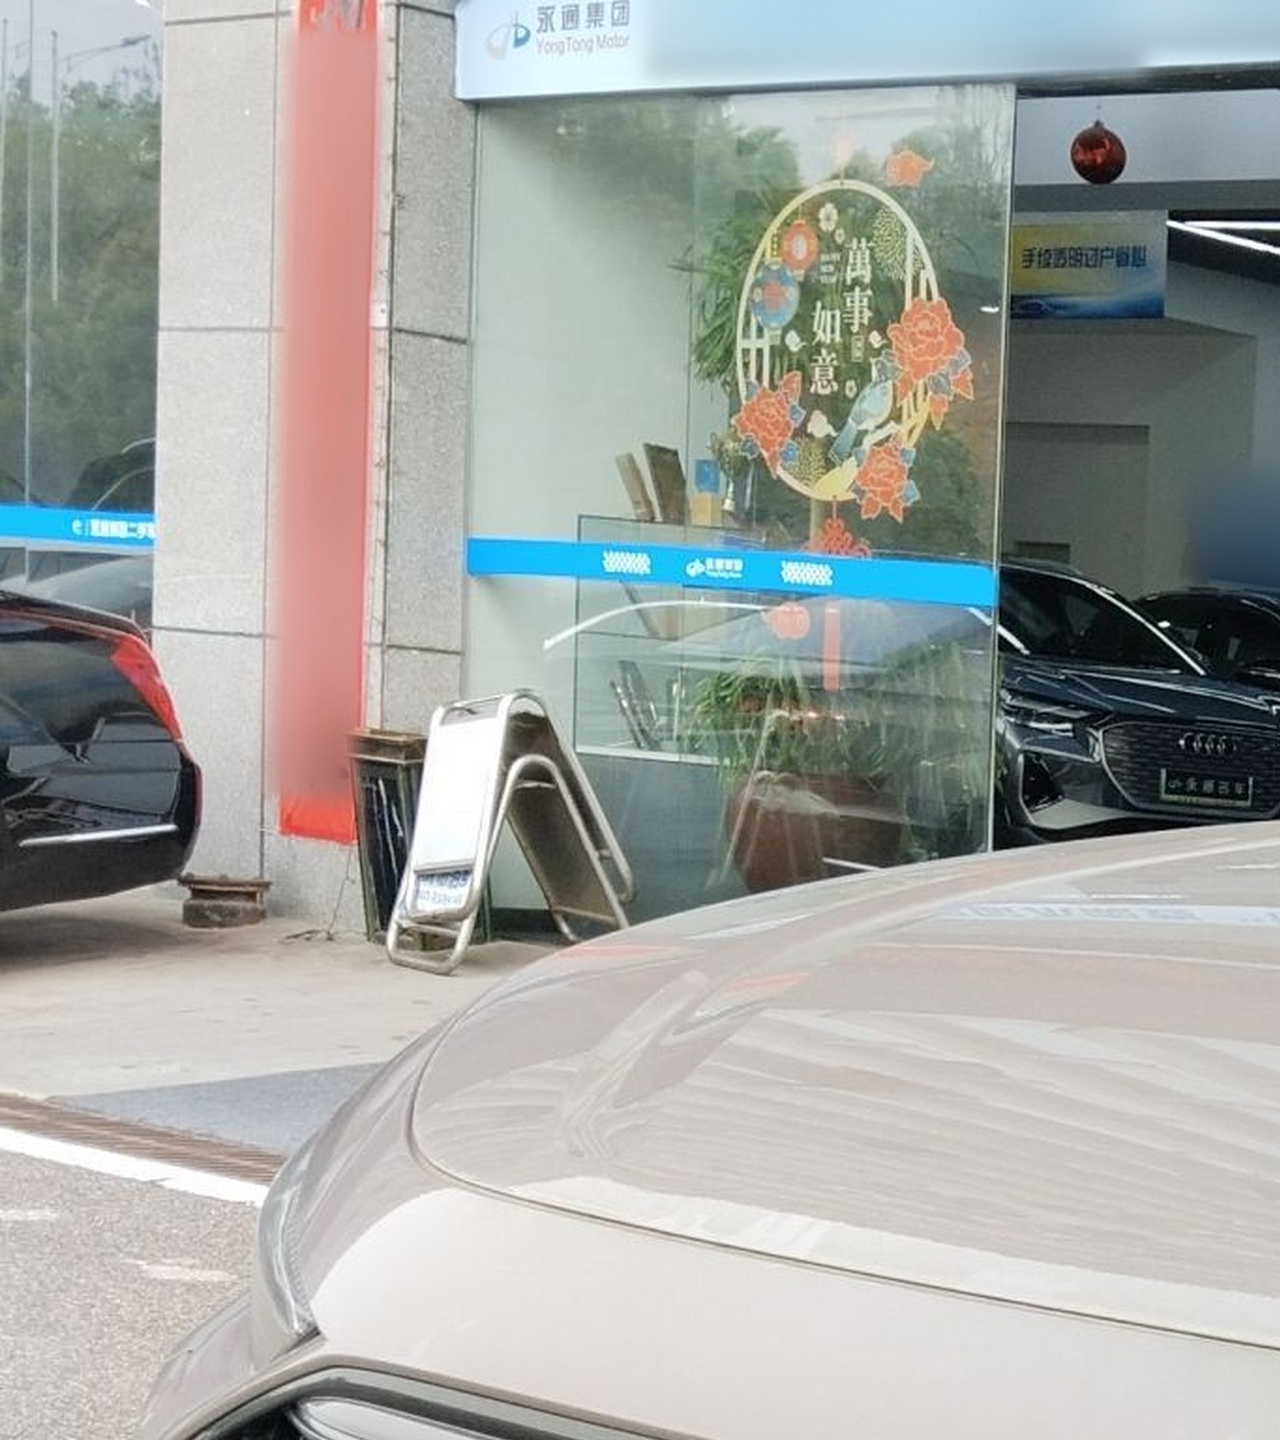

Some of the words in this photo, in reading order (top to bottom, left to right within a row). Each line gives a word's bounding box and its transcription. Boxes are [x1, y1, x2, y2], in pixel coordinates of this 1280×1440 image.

[536, 0, 630, 33] 永通集团
[843, 237, 875, 333] 萬事
[810, 300, 842, 395] 如意
